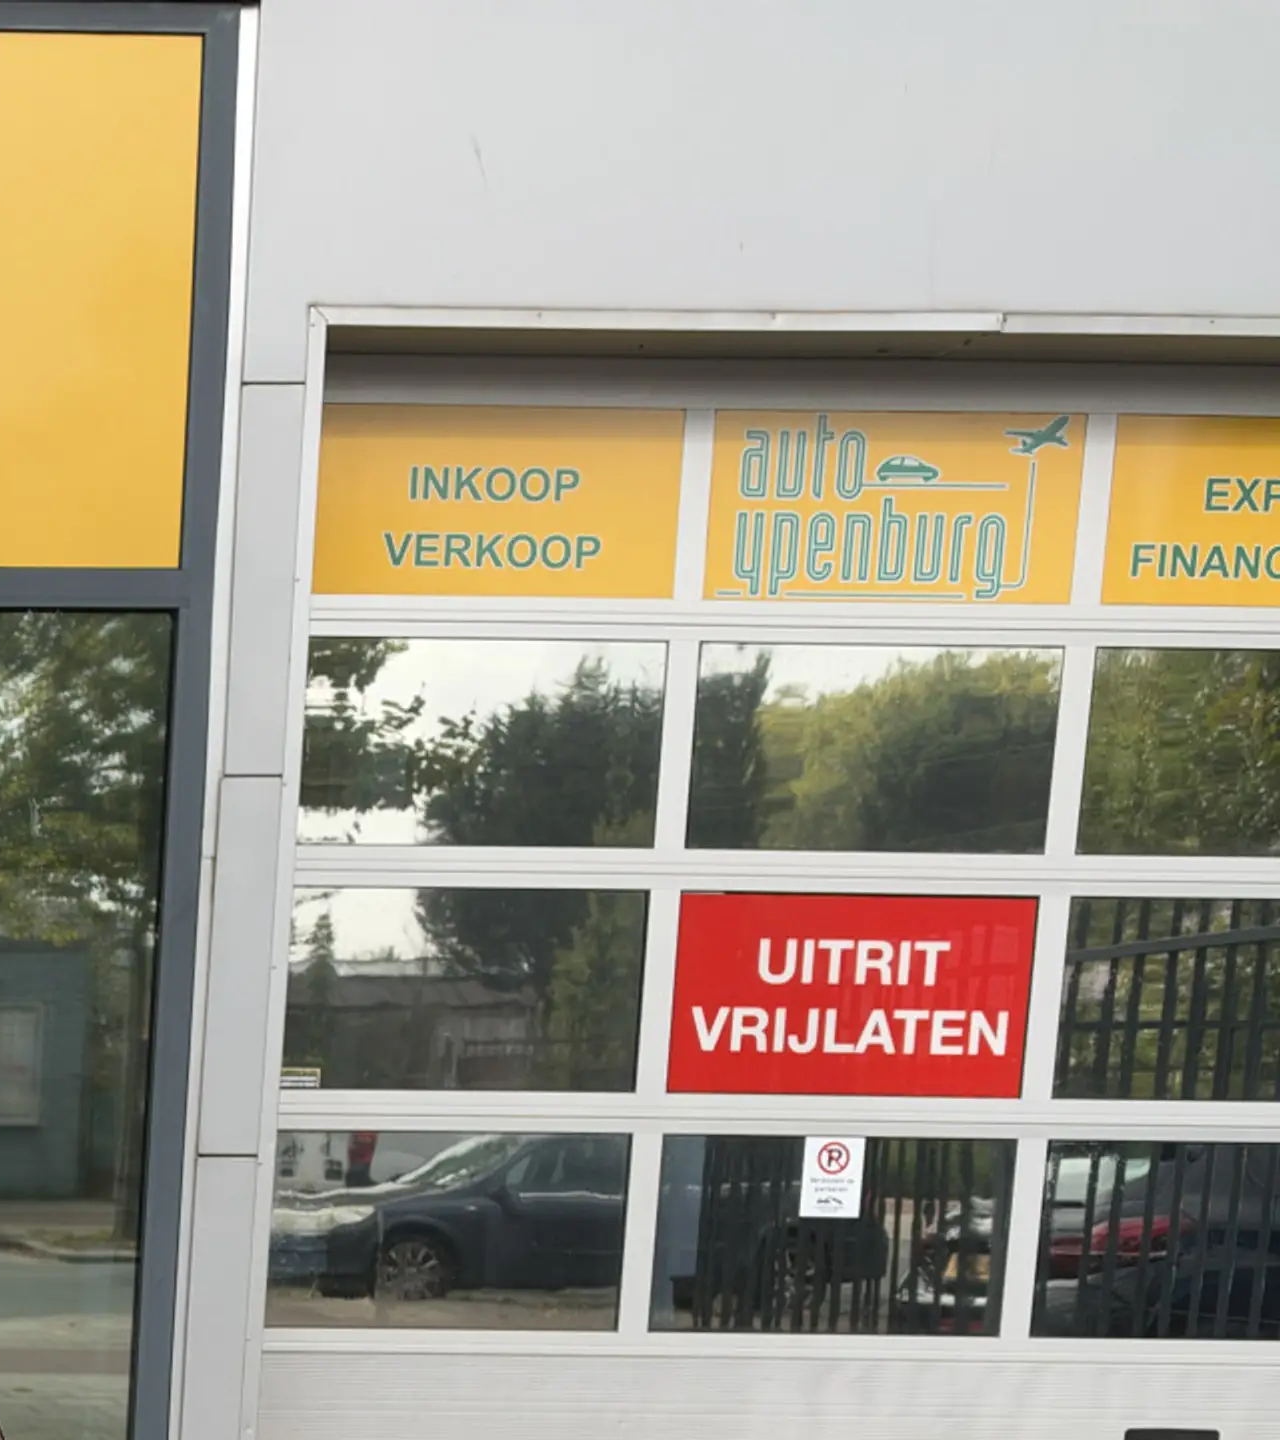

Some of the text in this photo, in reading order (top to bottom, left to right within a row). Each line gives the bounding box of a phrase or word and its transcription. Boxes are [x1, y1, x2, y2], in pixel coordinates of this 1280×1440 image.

[739, 413, 866, 500] auto
[407, 464, 582, 503] INKOOP
[383, 531, 603, 571] VERKOOP
[733, 497, 1008, 599] ypenburg
[756, 937, 951, 987] UITRIT
[691, 1006, 1010, 1056] VRIJLATEN
